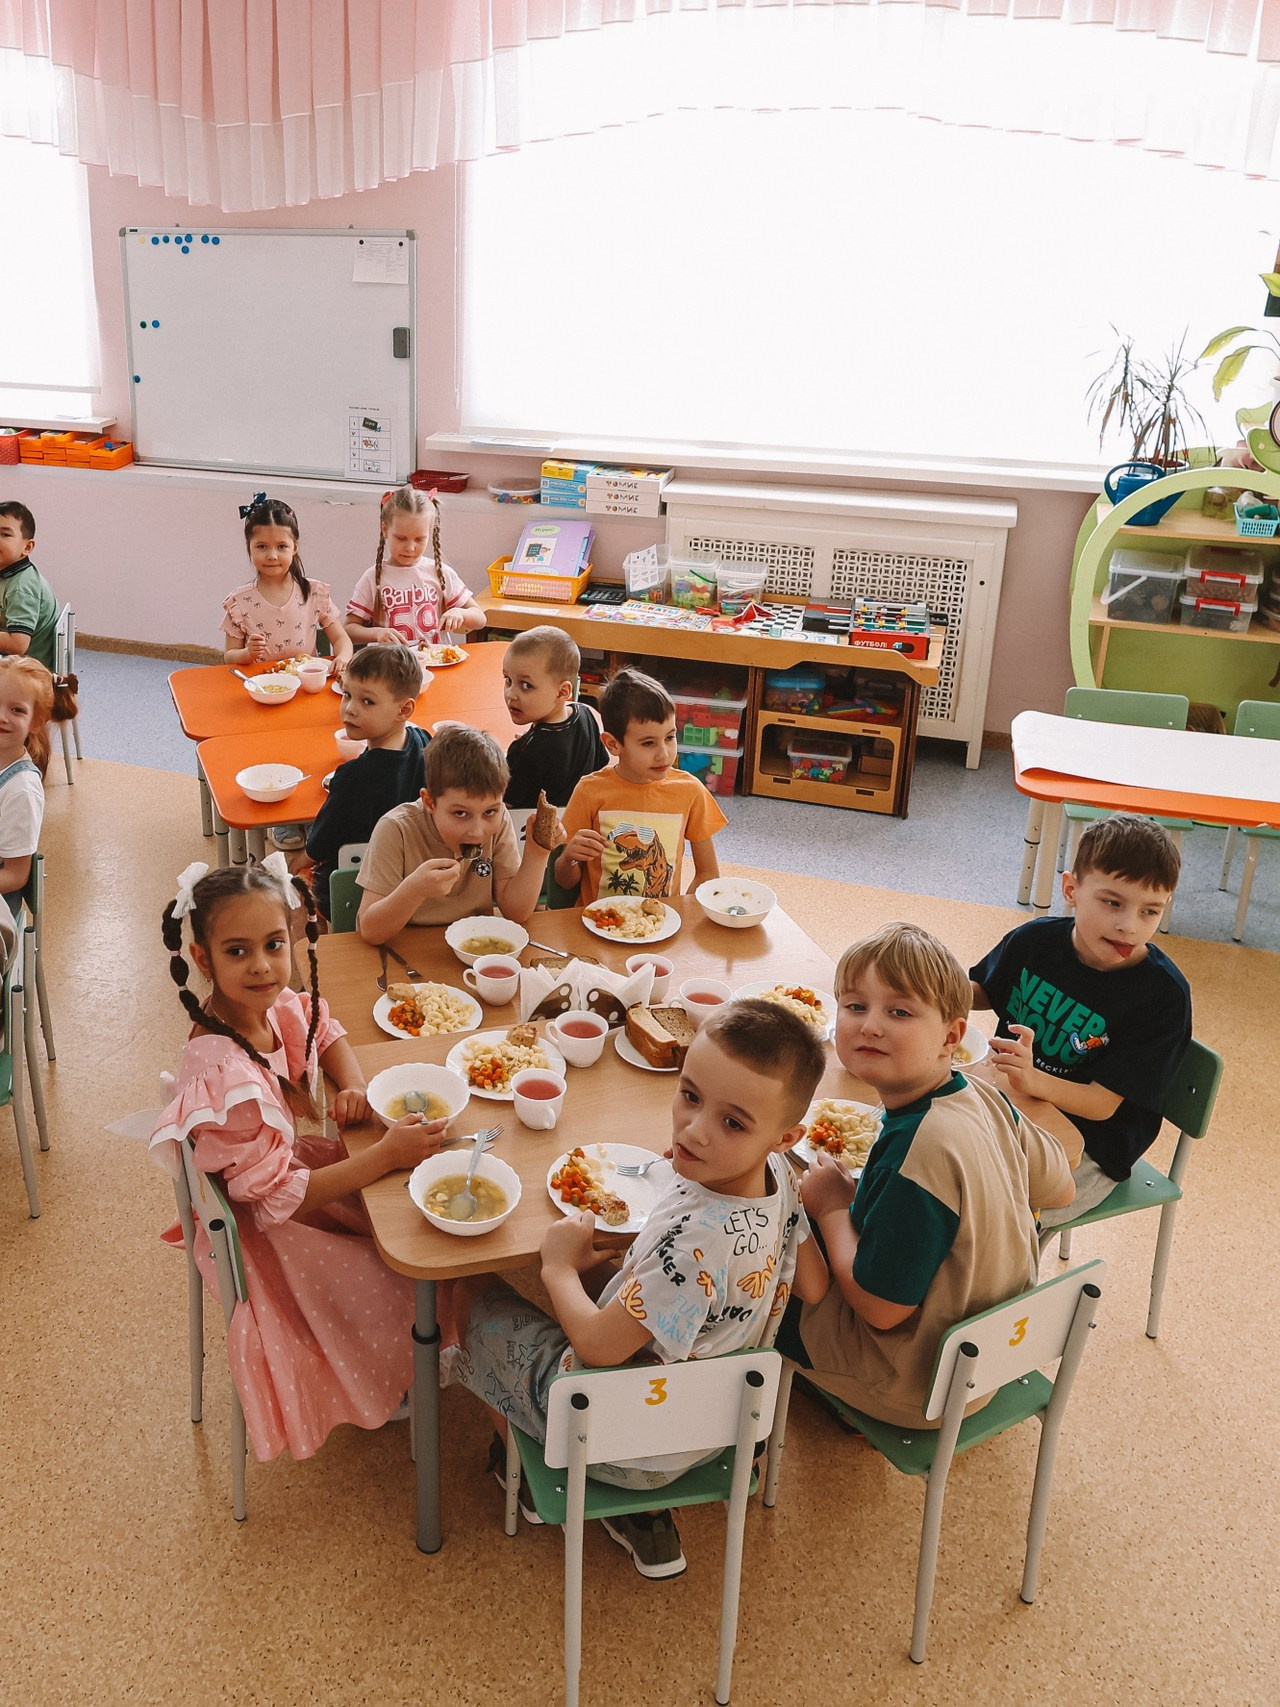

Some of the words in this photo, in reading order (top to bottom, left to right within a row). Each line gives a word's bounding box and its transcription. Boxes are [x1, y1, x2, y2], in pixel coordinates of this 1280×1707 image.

[381, 583, 438, 608] Barbie
[854, 640, 887, 648] ФУТБОЛ!
[1020, 967, 1106, 1041] NEVER
[723, 1207, 769, 1235] LET'S
[1009, 1316, 1029, 1347] 3
[645, 1377, 667, 1405] 3
